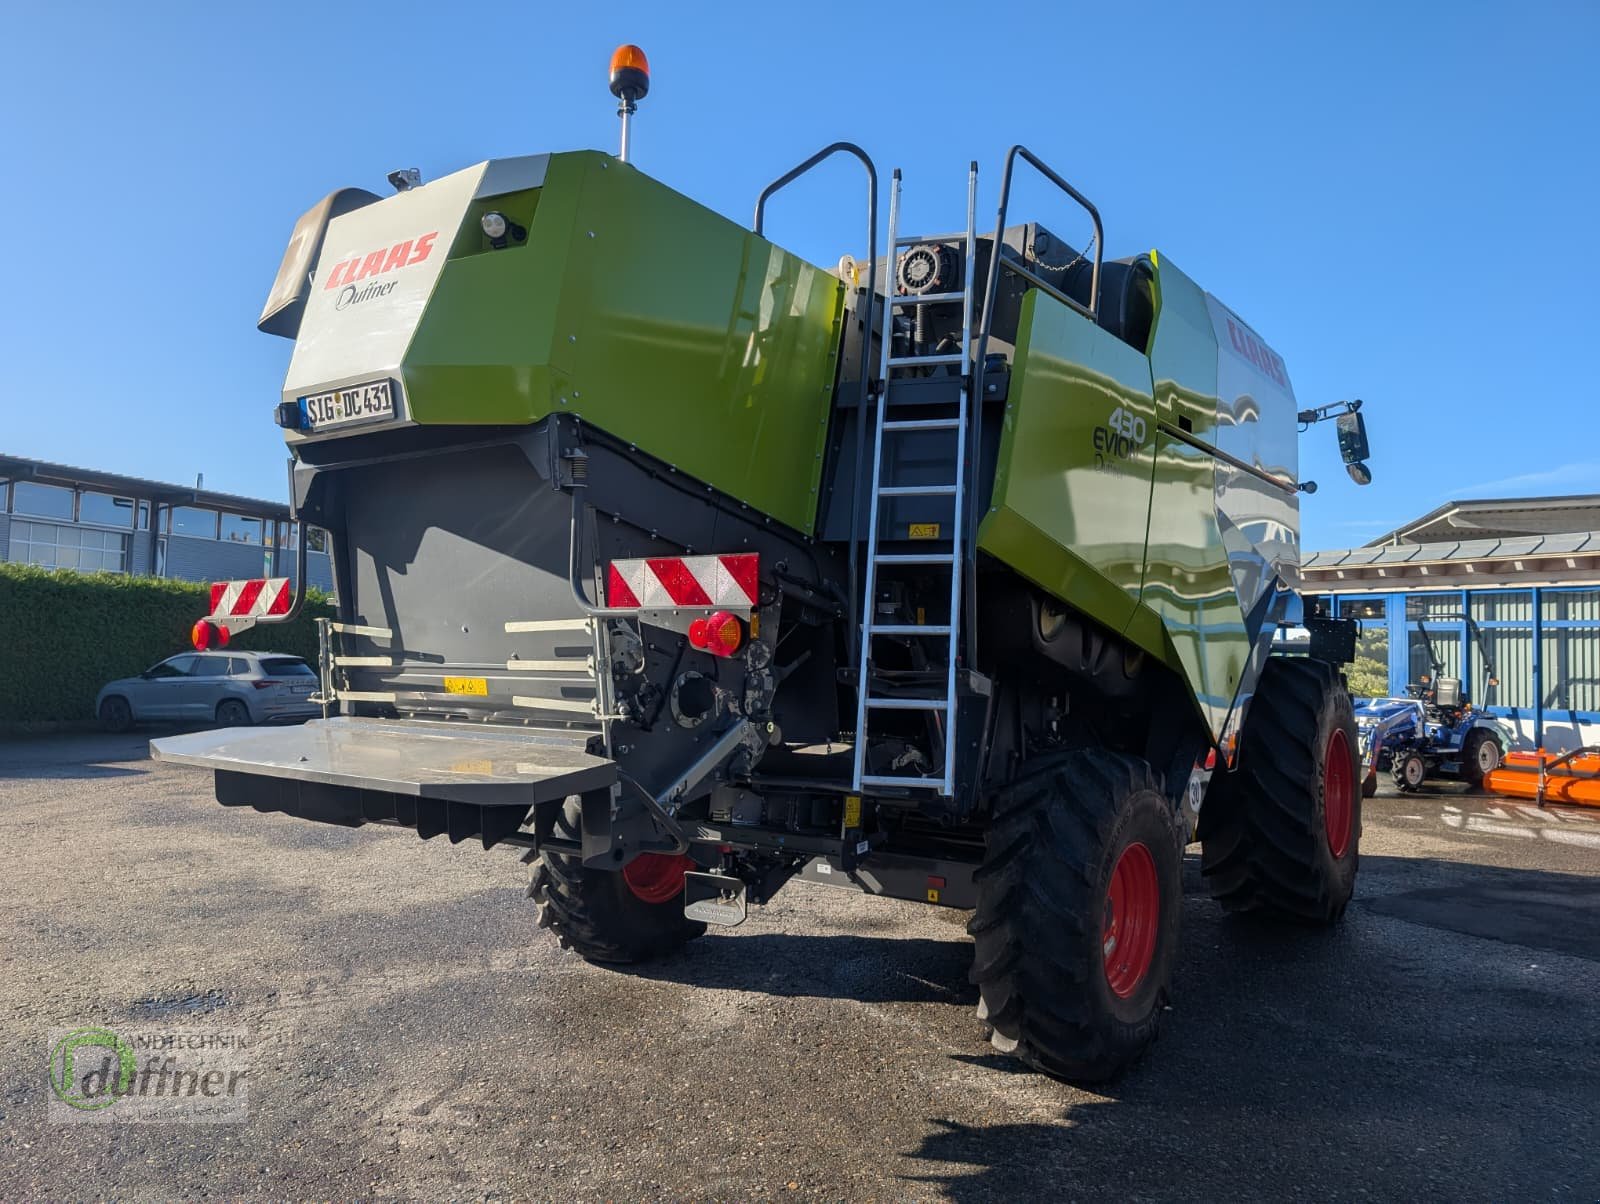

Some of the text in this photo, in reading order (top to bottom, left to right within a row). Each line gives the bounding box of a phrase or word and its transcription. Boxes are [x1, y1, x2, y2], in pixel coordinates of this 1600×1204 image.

[324, 231, 438, 290] CLAAS
[1226, 318, 1286, 388] CLAAS
[308, 384, 392, 423] SIG DC 431
[1108, 407, 1146, 444] 430
